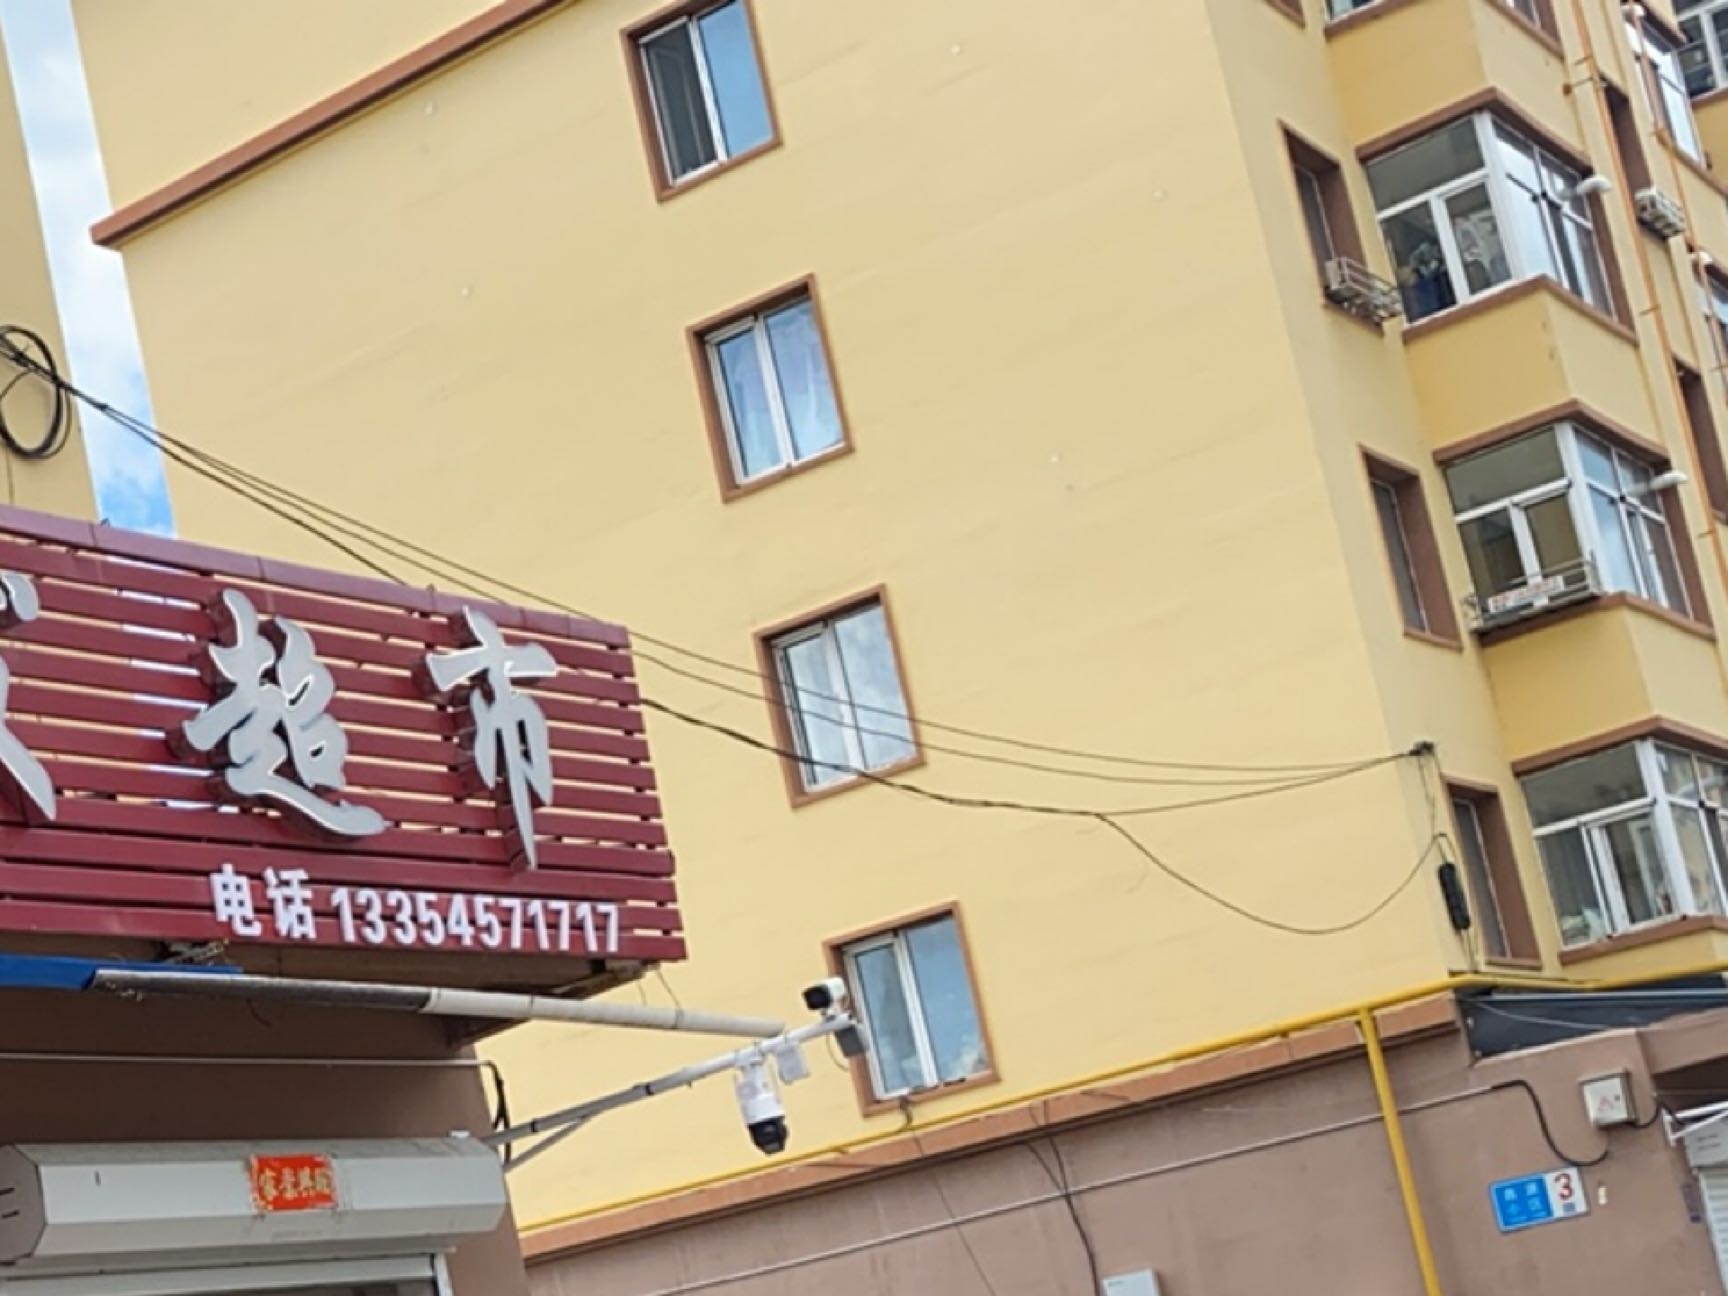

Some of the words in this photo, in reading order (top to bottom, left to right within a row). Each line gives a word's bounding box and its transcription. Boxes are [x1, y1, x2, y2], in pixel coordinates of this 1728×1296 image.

[210, 863, 317, 939] 电话
[330, 886, 620, 953] 13354571717
[1555, 1173, 1574, 1200] 3
